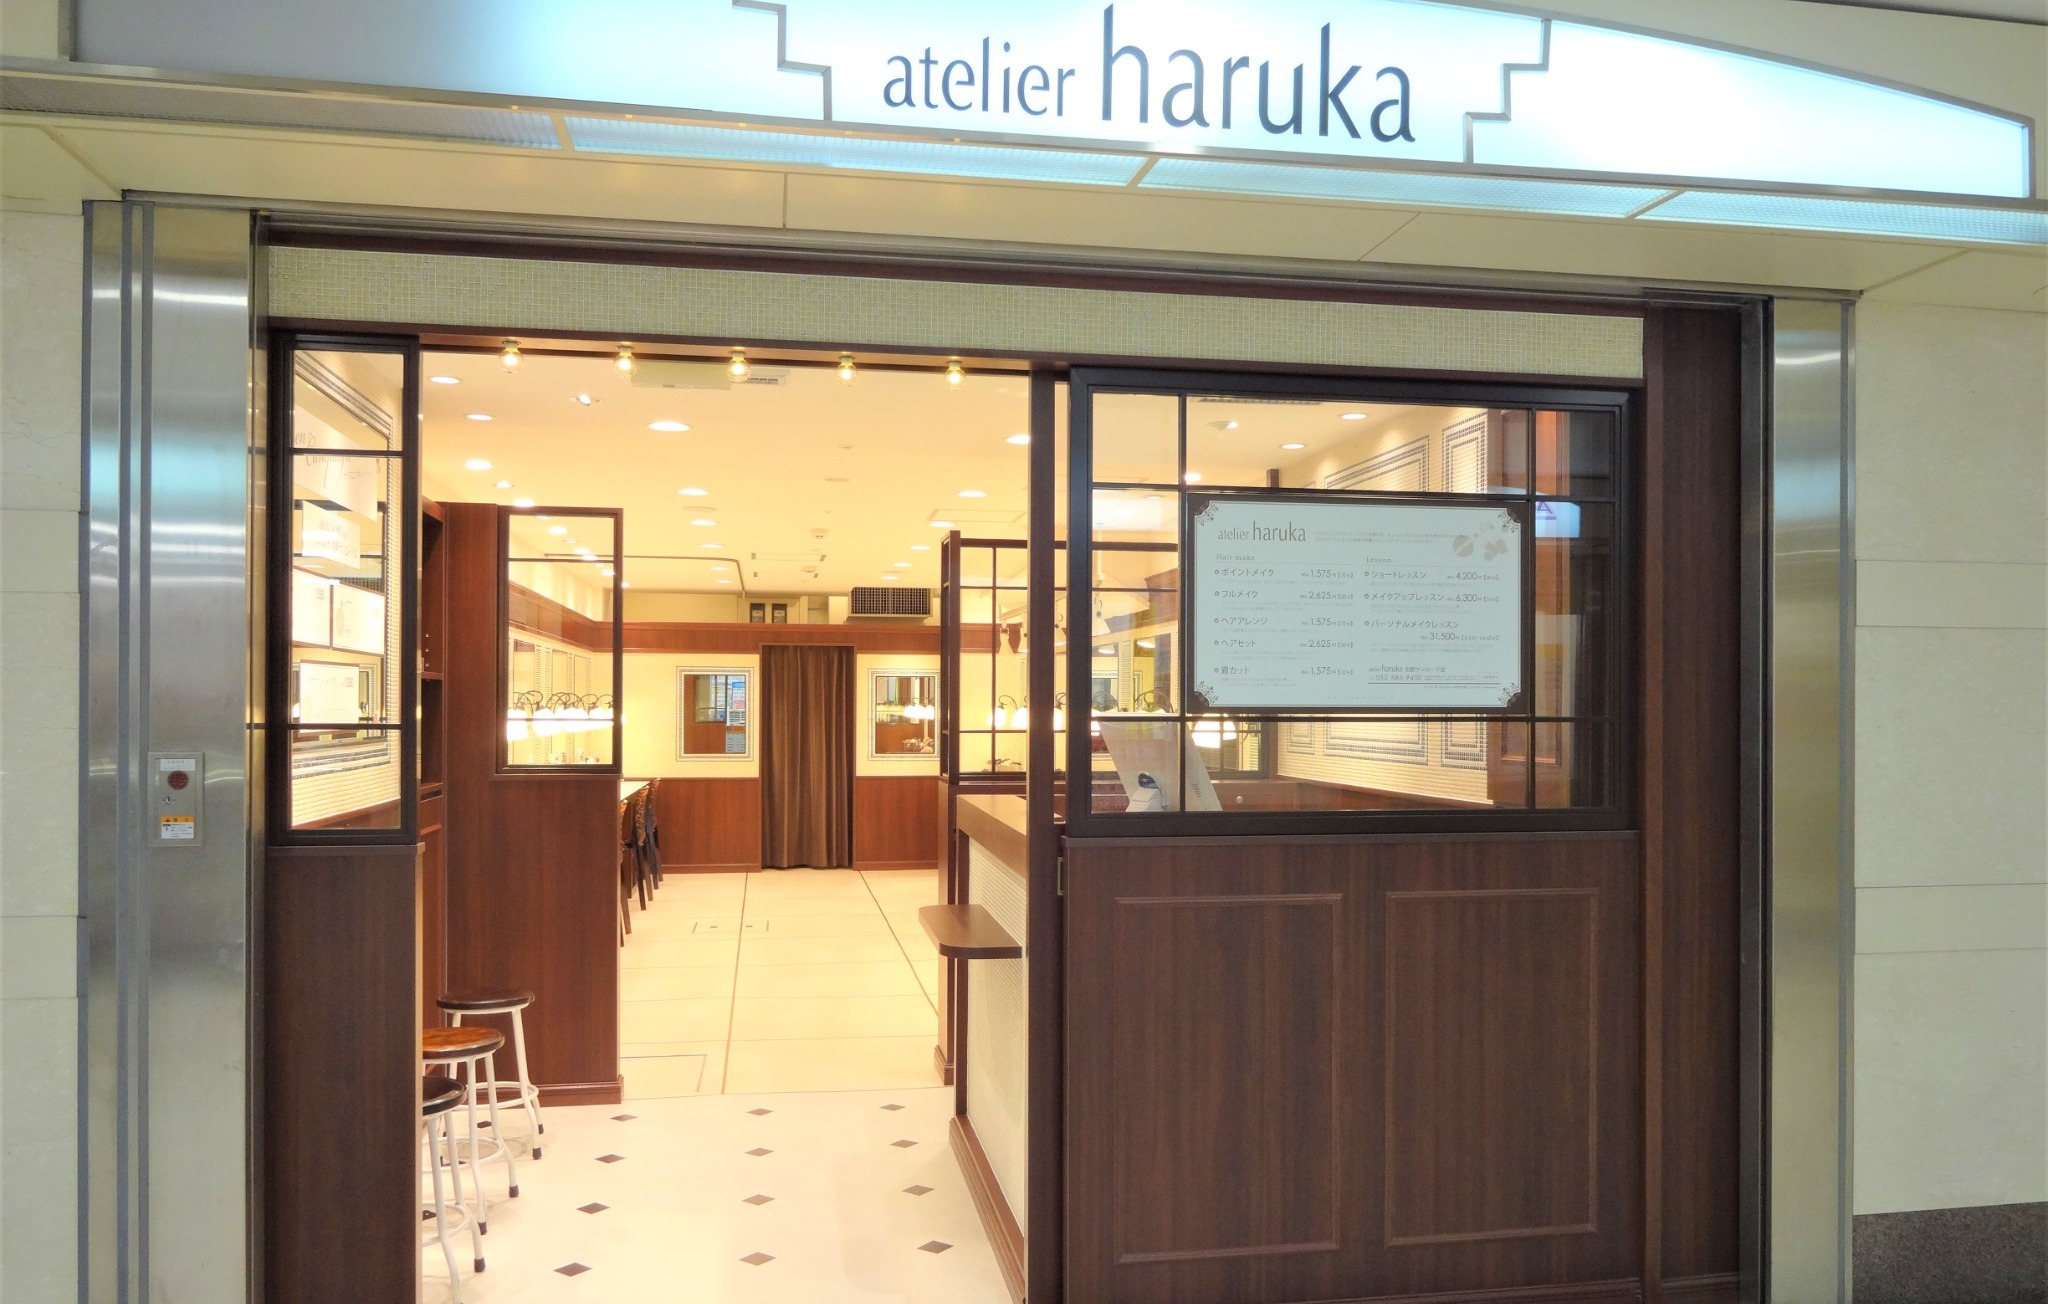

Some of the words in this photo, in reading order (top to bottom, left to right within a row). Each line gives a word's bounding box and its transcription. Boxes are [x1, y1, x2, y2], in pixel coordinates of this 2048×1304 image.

[883, 36, 1075, 116] atelier
[1102, 3, 1416, 143] haruka
[1217, 526, 1250, 541] atelier
[1252, 520, 1307, 542] haruka
[1221, 568, 1274, 577] ポイントメイク
[1371, 571, 1427, 579] ショートレッスン
[1221, 590, 1258, 598] フルメイク
[1371, 592, 1445, 601] メイクアップレッスン
[1221, 617, 1268, 625] ヘアアレンジ
[1371, 620, 1459, 629] パーソナルメイクレッスン
[1220, 639, 1256, 648] ヘアセット
[1221, 665, 1250, 675] 眉カット
